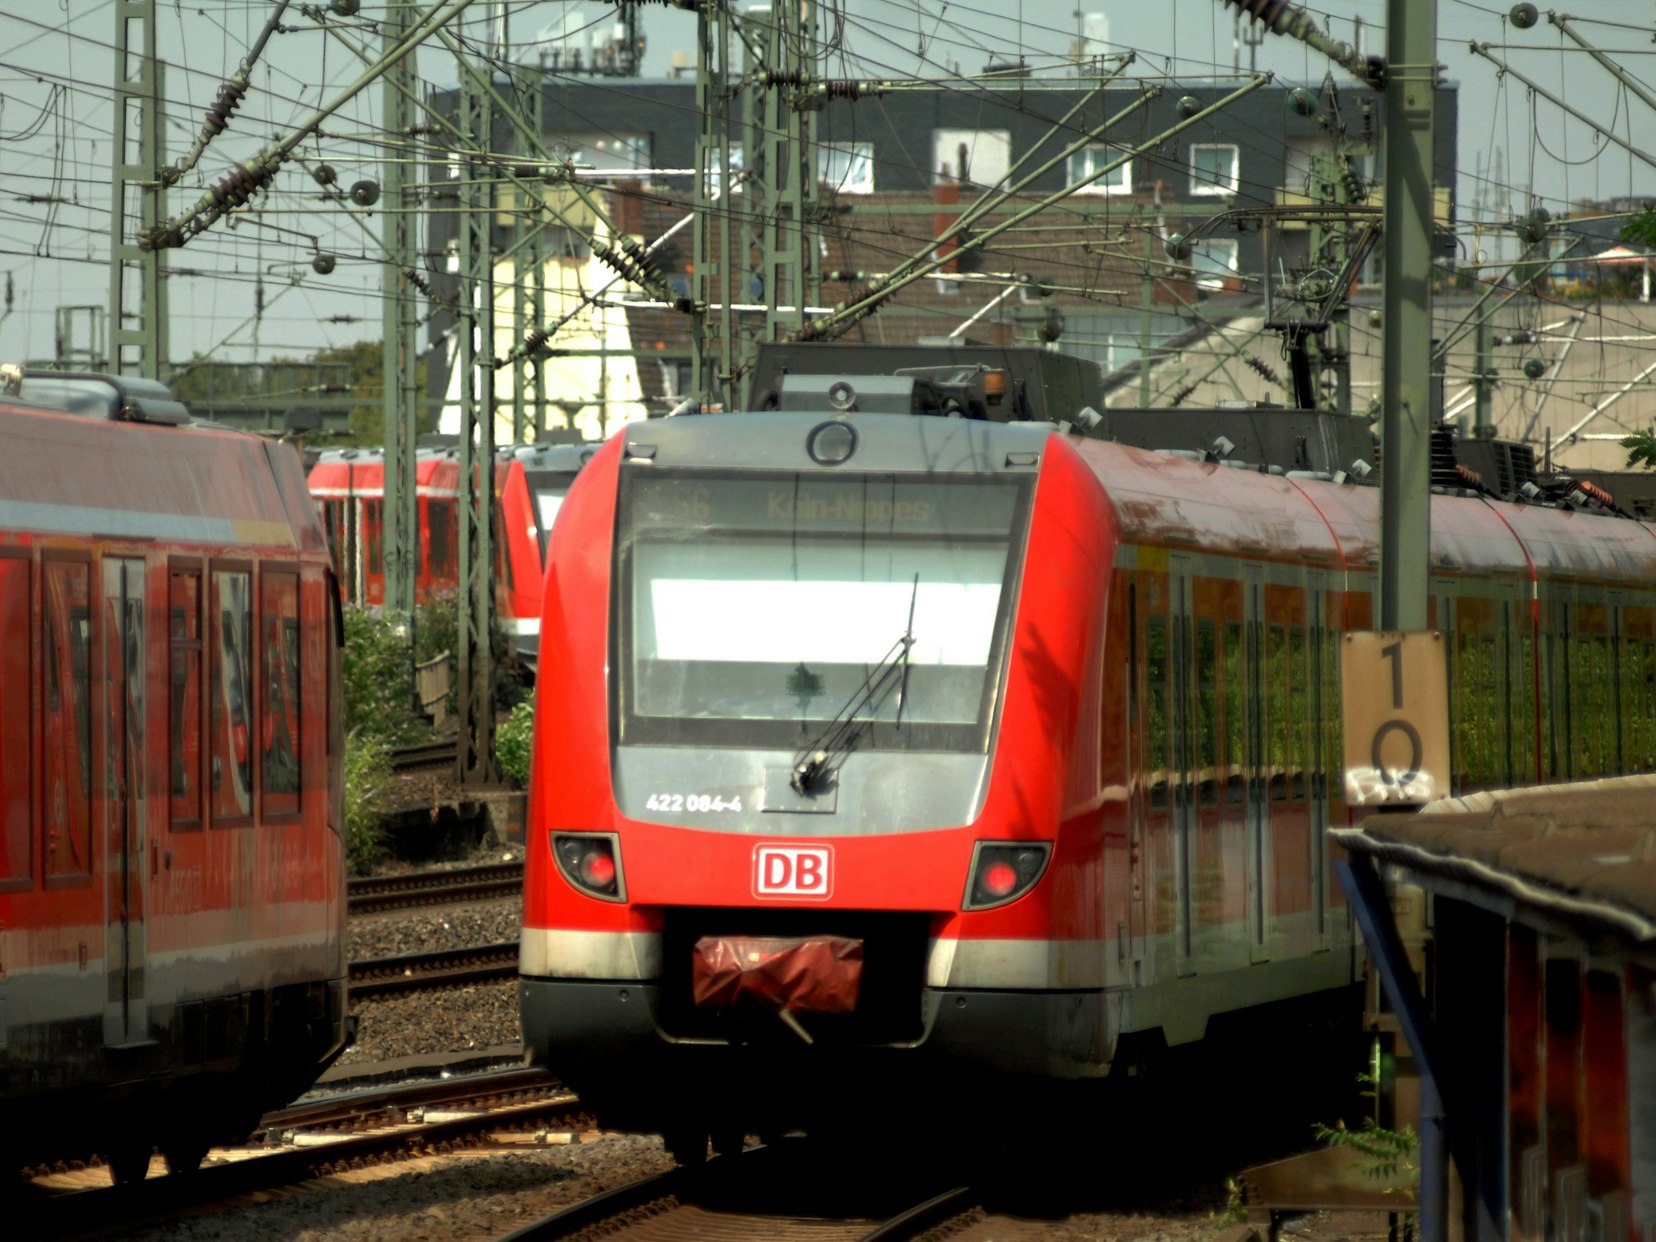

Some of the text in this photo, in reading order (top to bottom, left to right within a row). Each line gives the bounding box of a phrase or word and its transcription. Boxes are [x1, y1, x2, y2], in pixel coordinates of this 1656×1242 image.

[1381, 641, 1404, 709] 1
[646, 794, 742, 813] 422 084-4
[763, 853, 823, 890] DB
